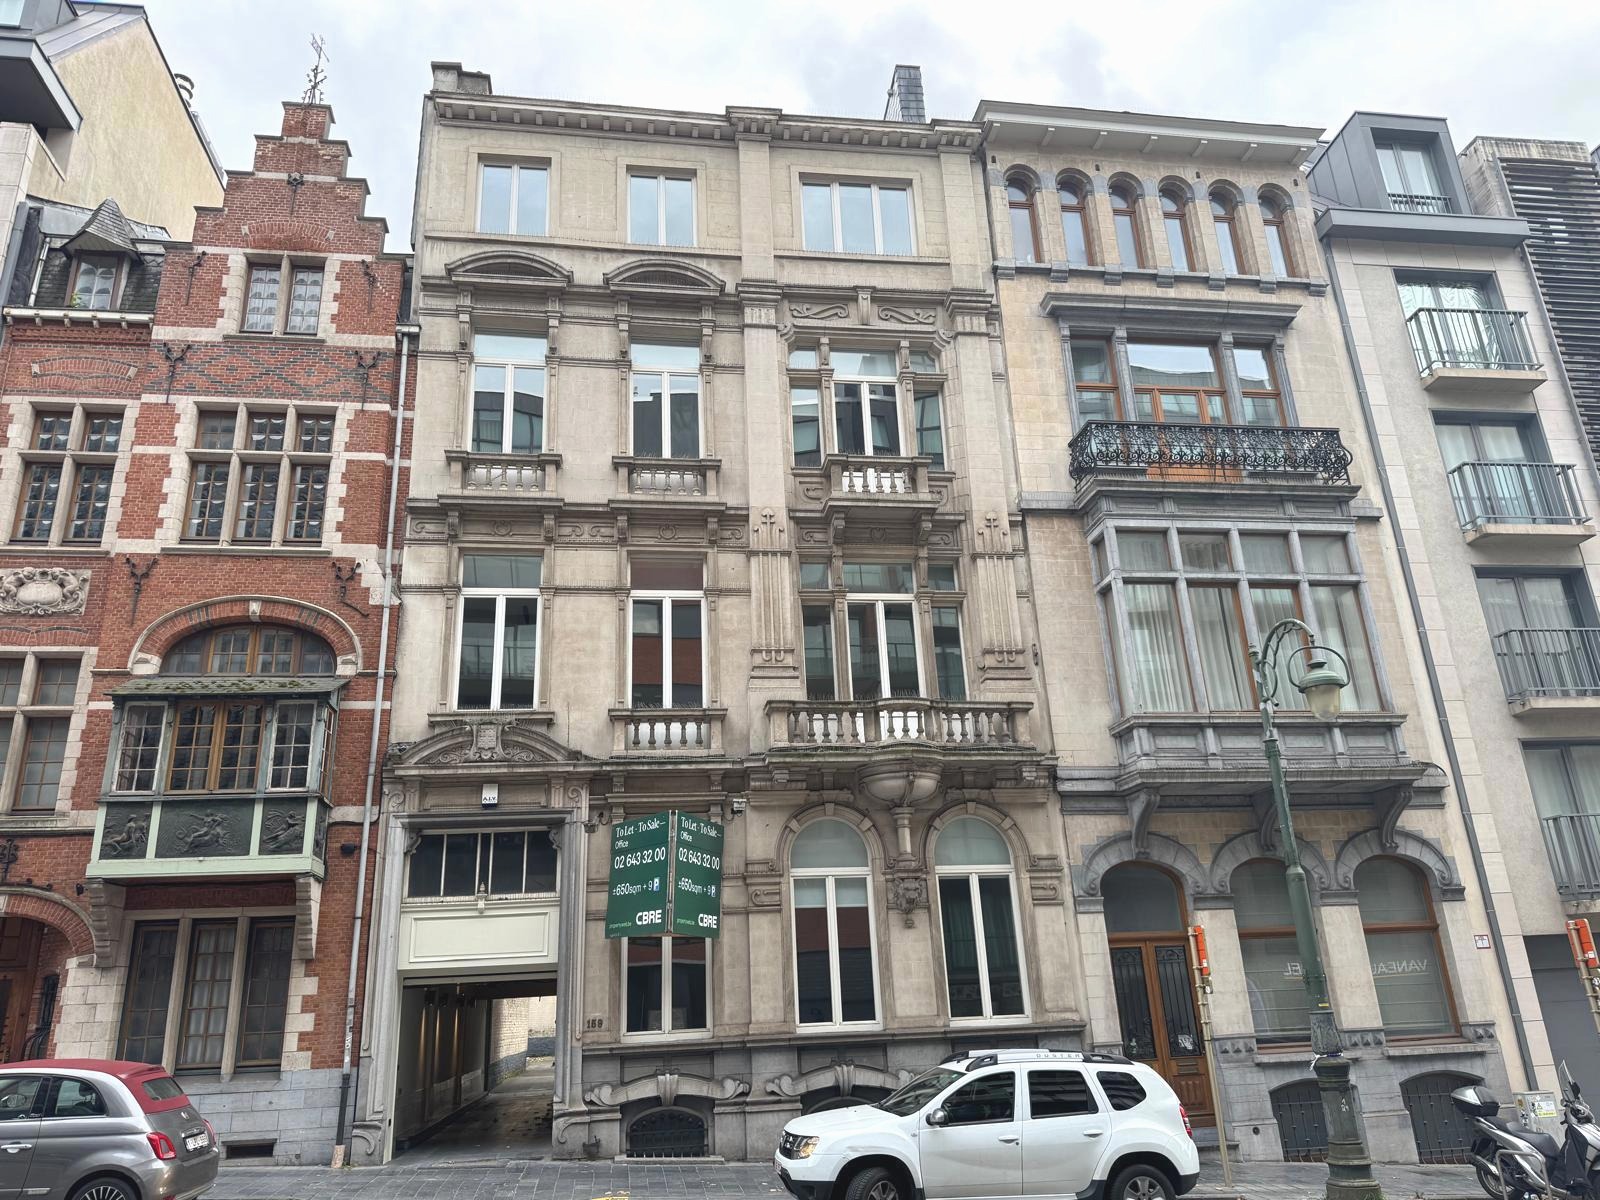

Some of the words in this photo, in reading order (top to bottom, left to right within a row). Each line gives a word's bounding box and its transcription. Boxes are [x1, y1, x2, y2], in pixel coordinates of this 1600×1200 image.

[616, 827, 625, 838] To
[625, 825, 634, 836] Let
[638, 821, 647, 833] To
[647, 818, 660, 831] Sale
[681, 816, 688, 828] To
[688, 819, 697, 832] Let
[699, 822, 707, 834] To
[707, 825, 717, 838] Sale
[681, 830, 692, 841] Office
[615, 840, 629, 849] Office
[614, 856, 625, 869] 02
[626, 852, 641, 867] 643
[642, 849, 653, 864] 32
[654, 846, 666, 861] 00
[679, 847, 688, 862] 02
[688, 850, 702, 865] 643
[702, 853, 711, 868] 32
[711, 856, 720, 870] 00
[636, 909, 662, 925] CBRE
[698, 913, 718, 928] CBRE
